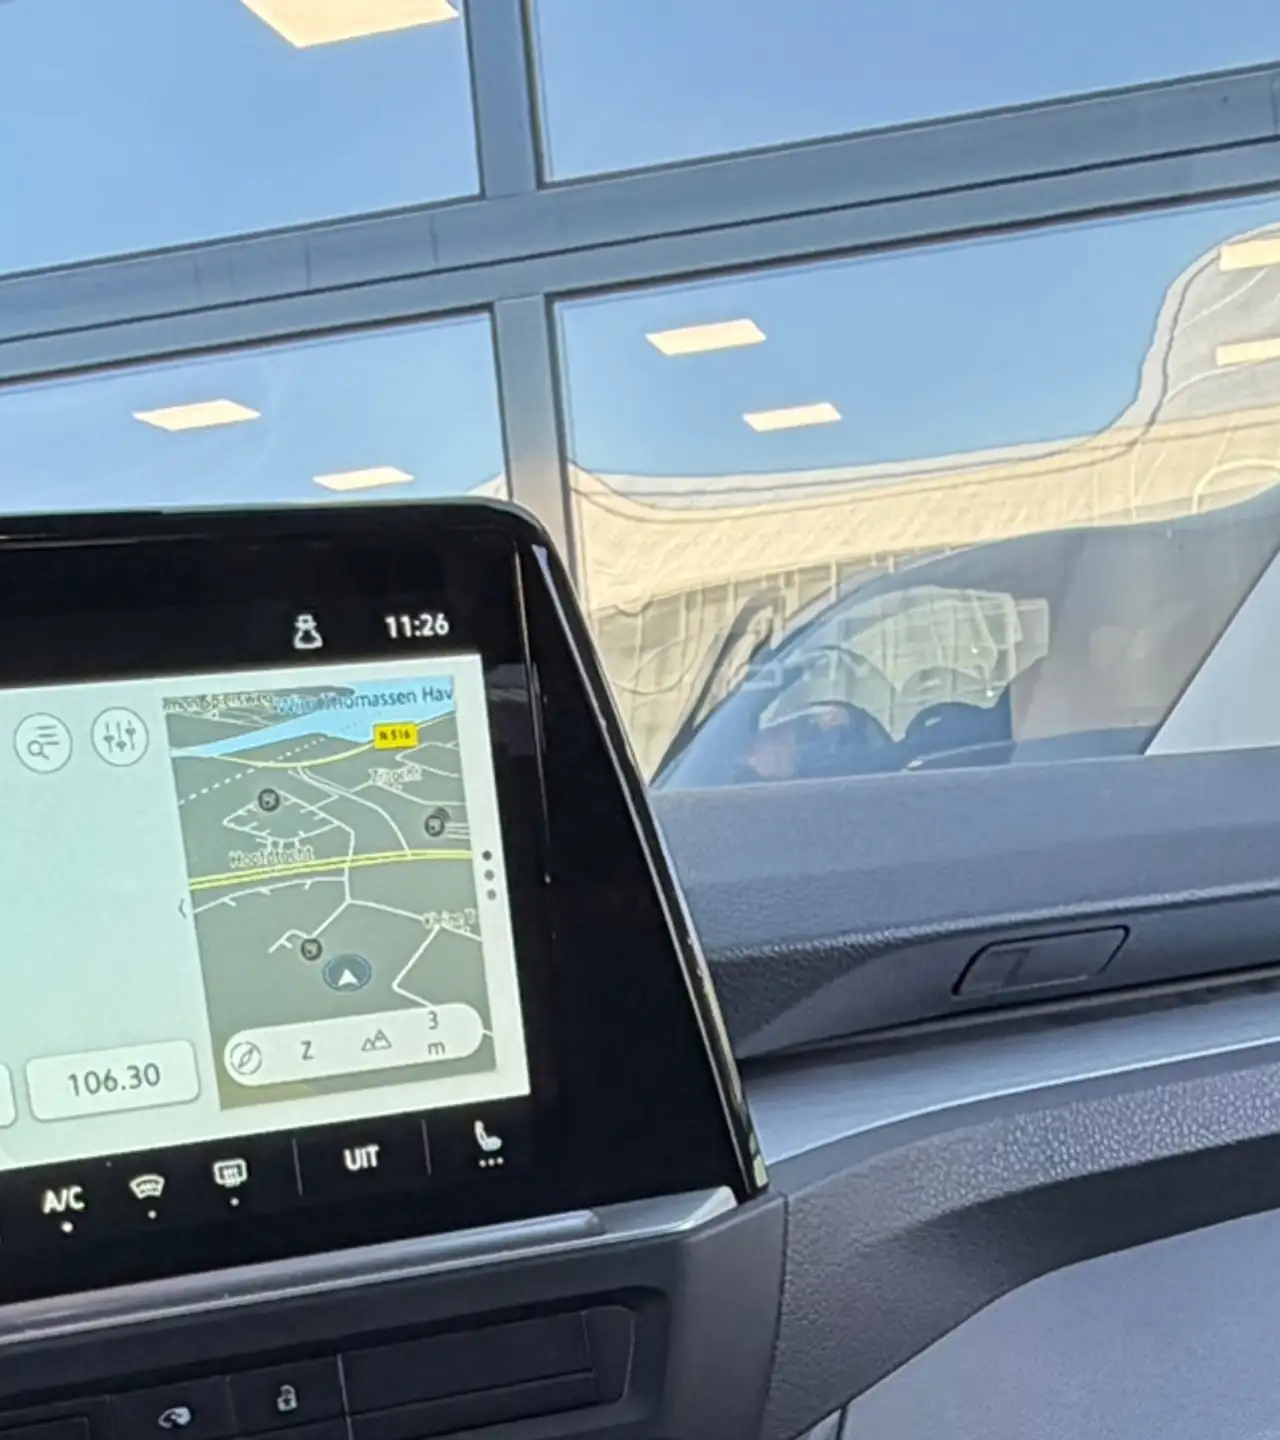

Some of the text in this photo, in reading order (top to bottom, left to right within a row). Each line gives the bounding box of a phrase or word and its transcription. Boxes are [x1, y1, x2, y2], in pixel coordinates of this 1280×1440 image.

[386, 613, 450, 638] 11:26
[428, 1012, 439, 1030] 3
[301, 1041, 314, 1061] Z
[427, 1041, 445, 1056] m
[67, 1063, 162, 1097] 106.30
[344, 1145, 380, 1171] UIT
[43, 1186, 85, 1214] A/C
